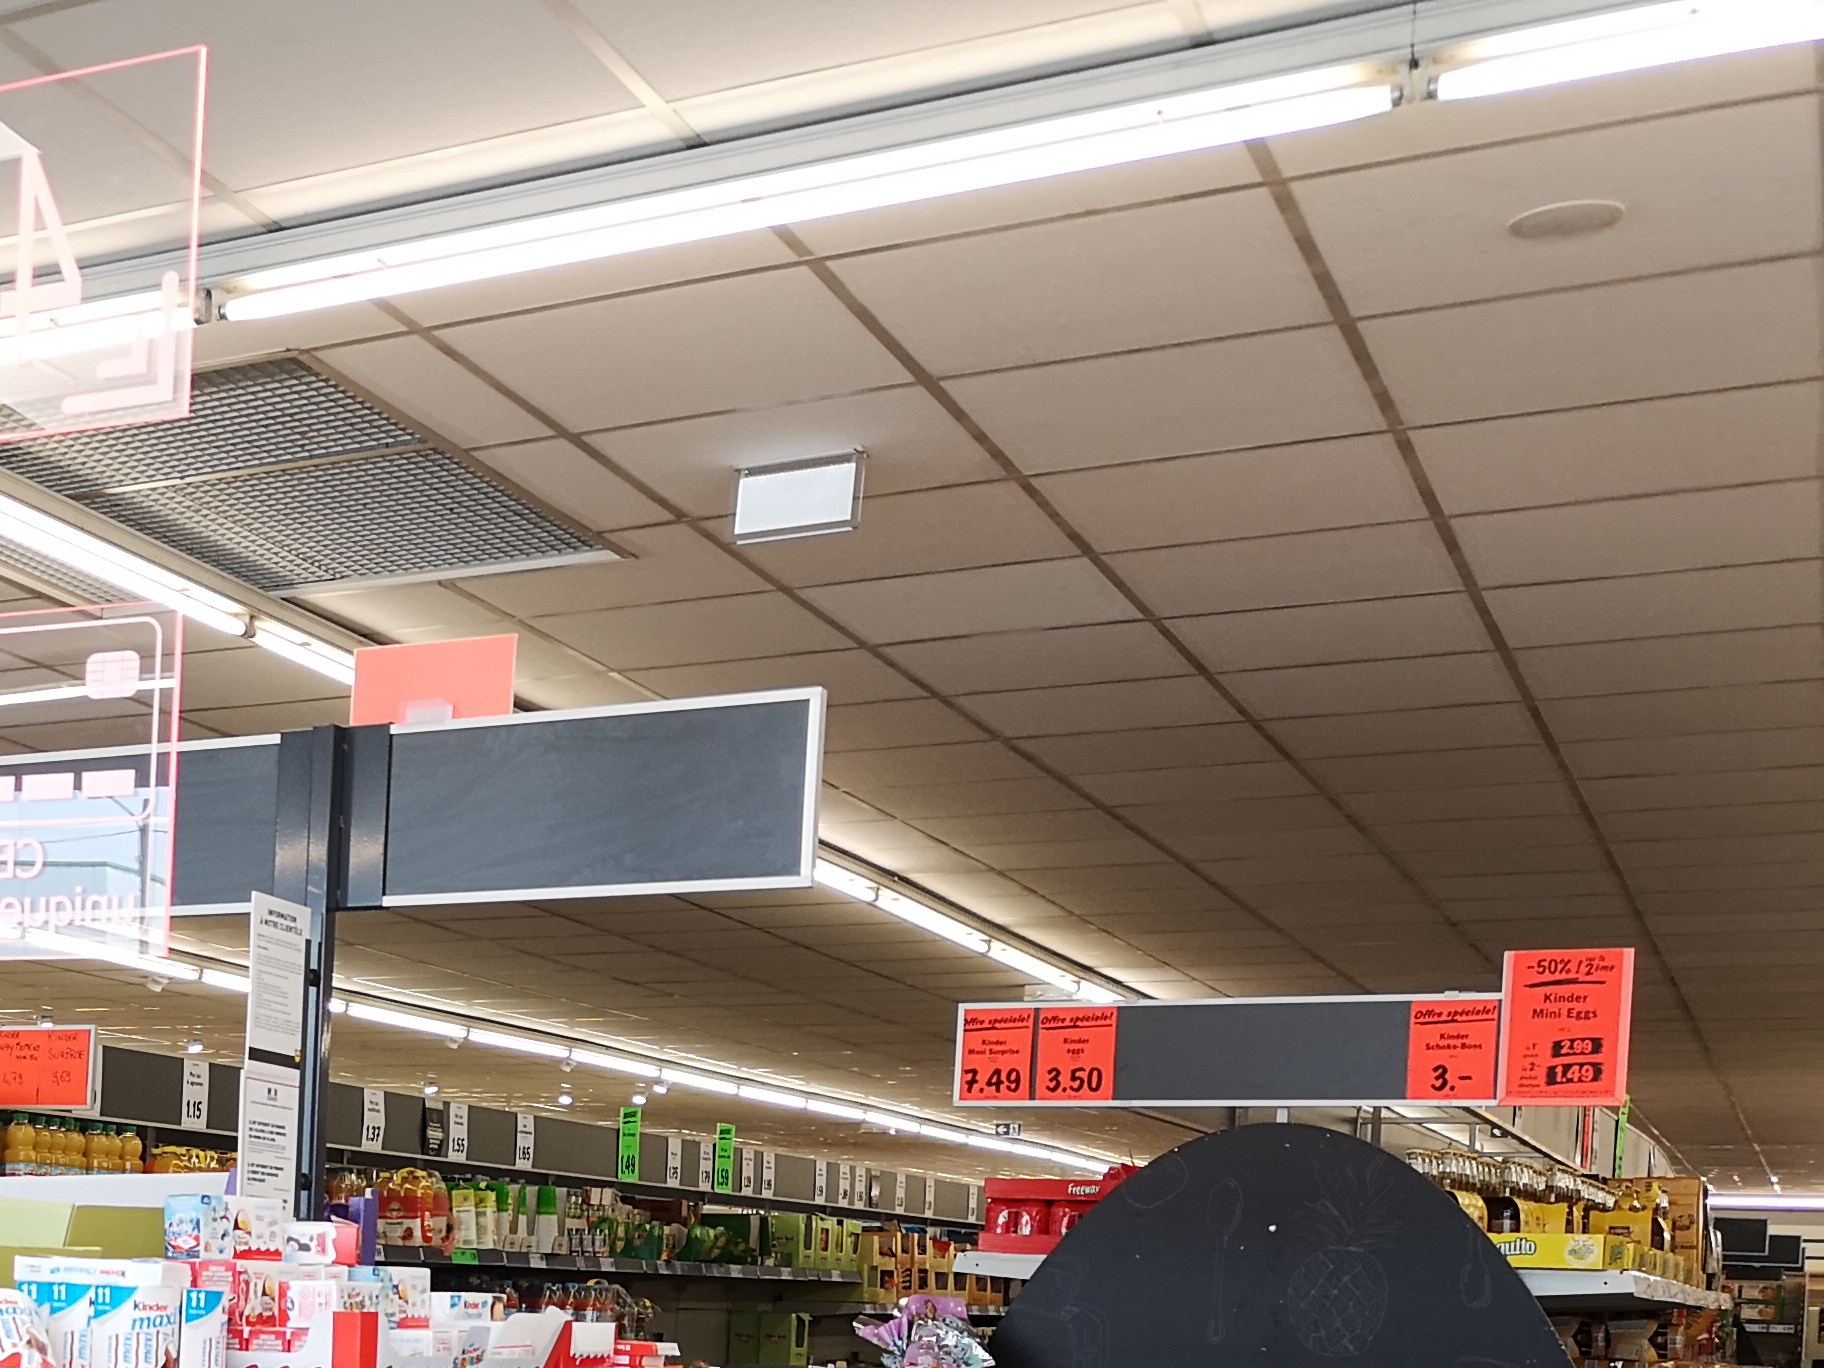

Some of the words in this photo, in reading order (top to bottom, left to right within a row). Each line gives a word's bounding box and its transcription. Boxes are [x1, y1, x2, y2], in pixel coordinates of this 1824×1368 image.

[1543, 993, 1588, 1004] Kinder
[1041, 1015, 1066, 1025] Offre
[1413, 1007, 1443, 1020] Offre
[1531, 1008, 1562, 1020] Mini
[1566, 1007, 1599, 1022] Eggs
[1063, 1037, 1090, 1045] Kinder
[1439, 1032, 1469, 1040] Kinder
[1560, 1040, 1593, 1055] 2.99
[963, 1067, 1021, 1094] 7.49
[1045, 1066, 1103, 1094] 3.50
[1430, 1064, 1473, 1092] 3.-
[1554, 1064, 1595, 1083] 1.49
[186, 1099, 203, 1120] 1.15
[620, 1154, 636, 1176] 1.49
[716, 1168, 729, 1187] 1.59
[1068, 1183, 1100, 1196] Freeway
[52, 1284, 67, 1301] 11
[97, 1286, 111, 1303] 11
[189, 1291, 207, 1308] 11
